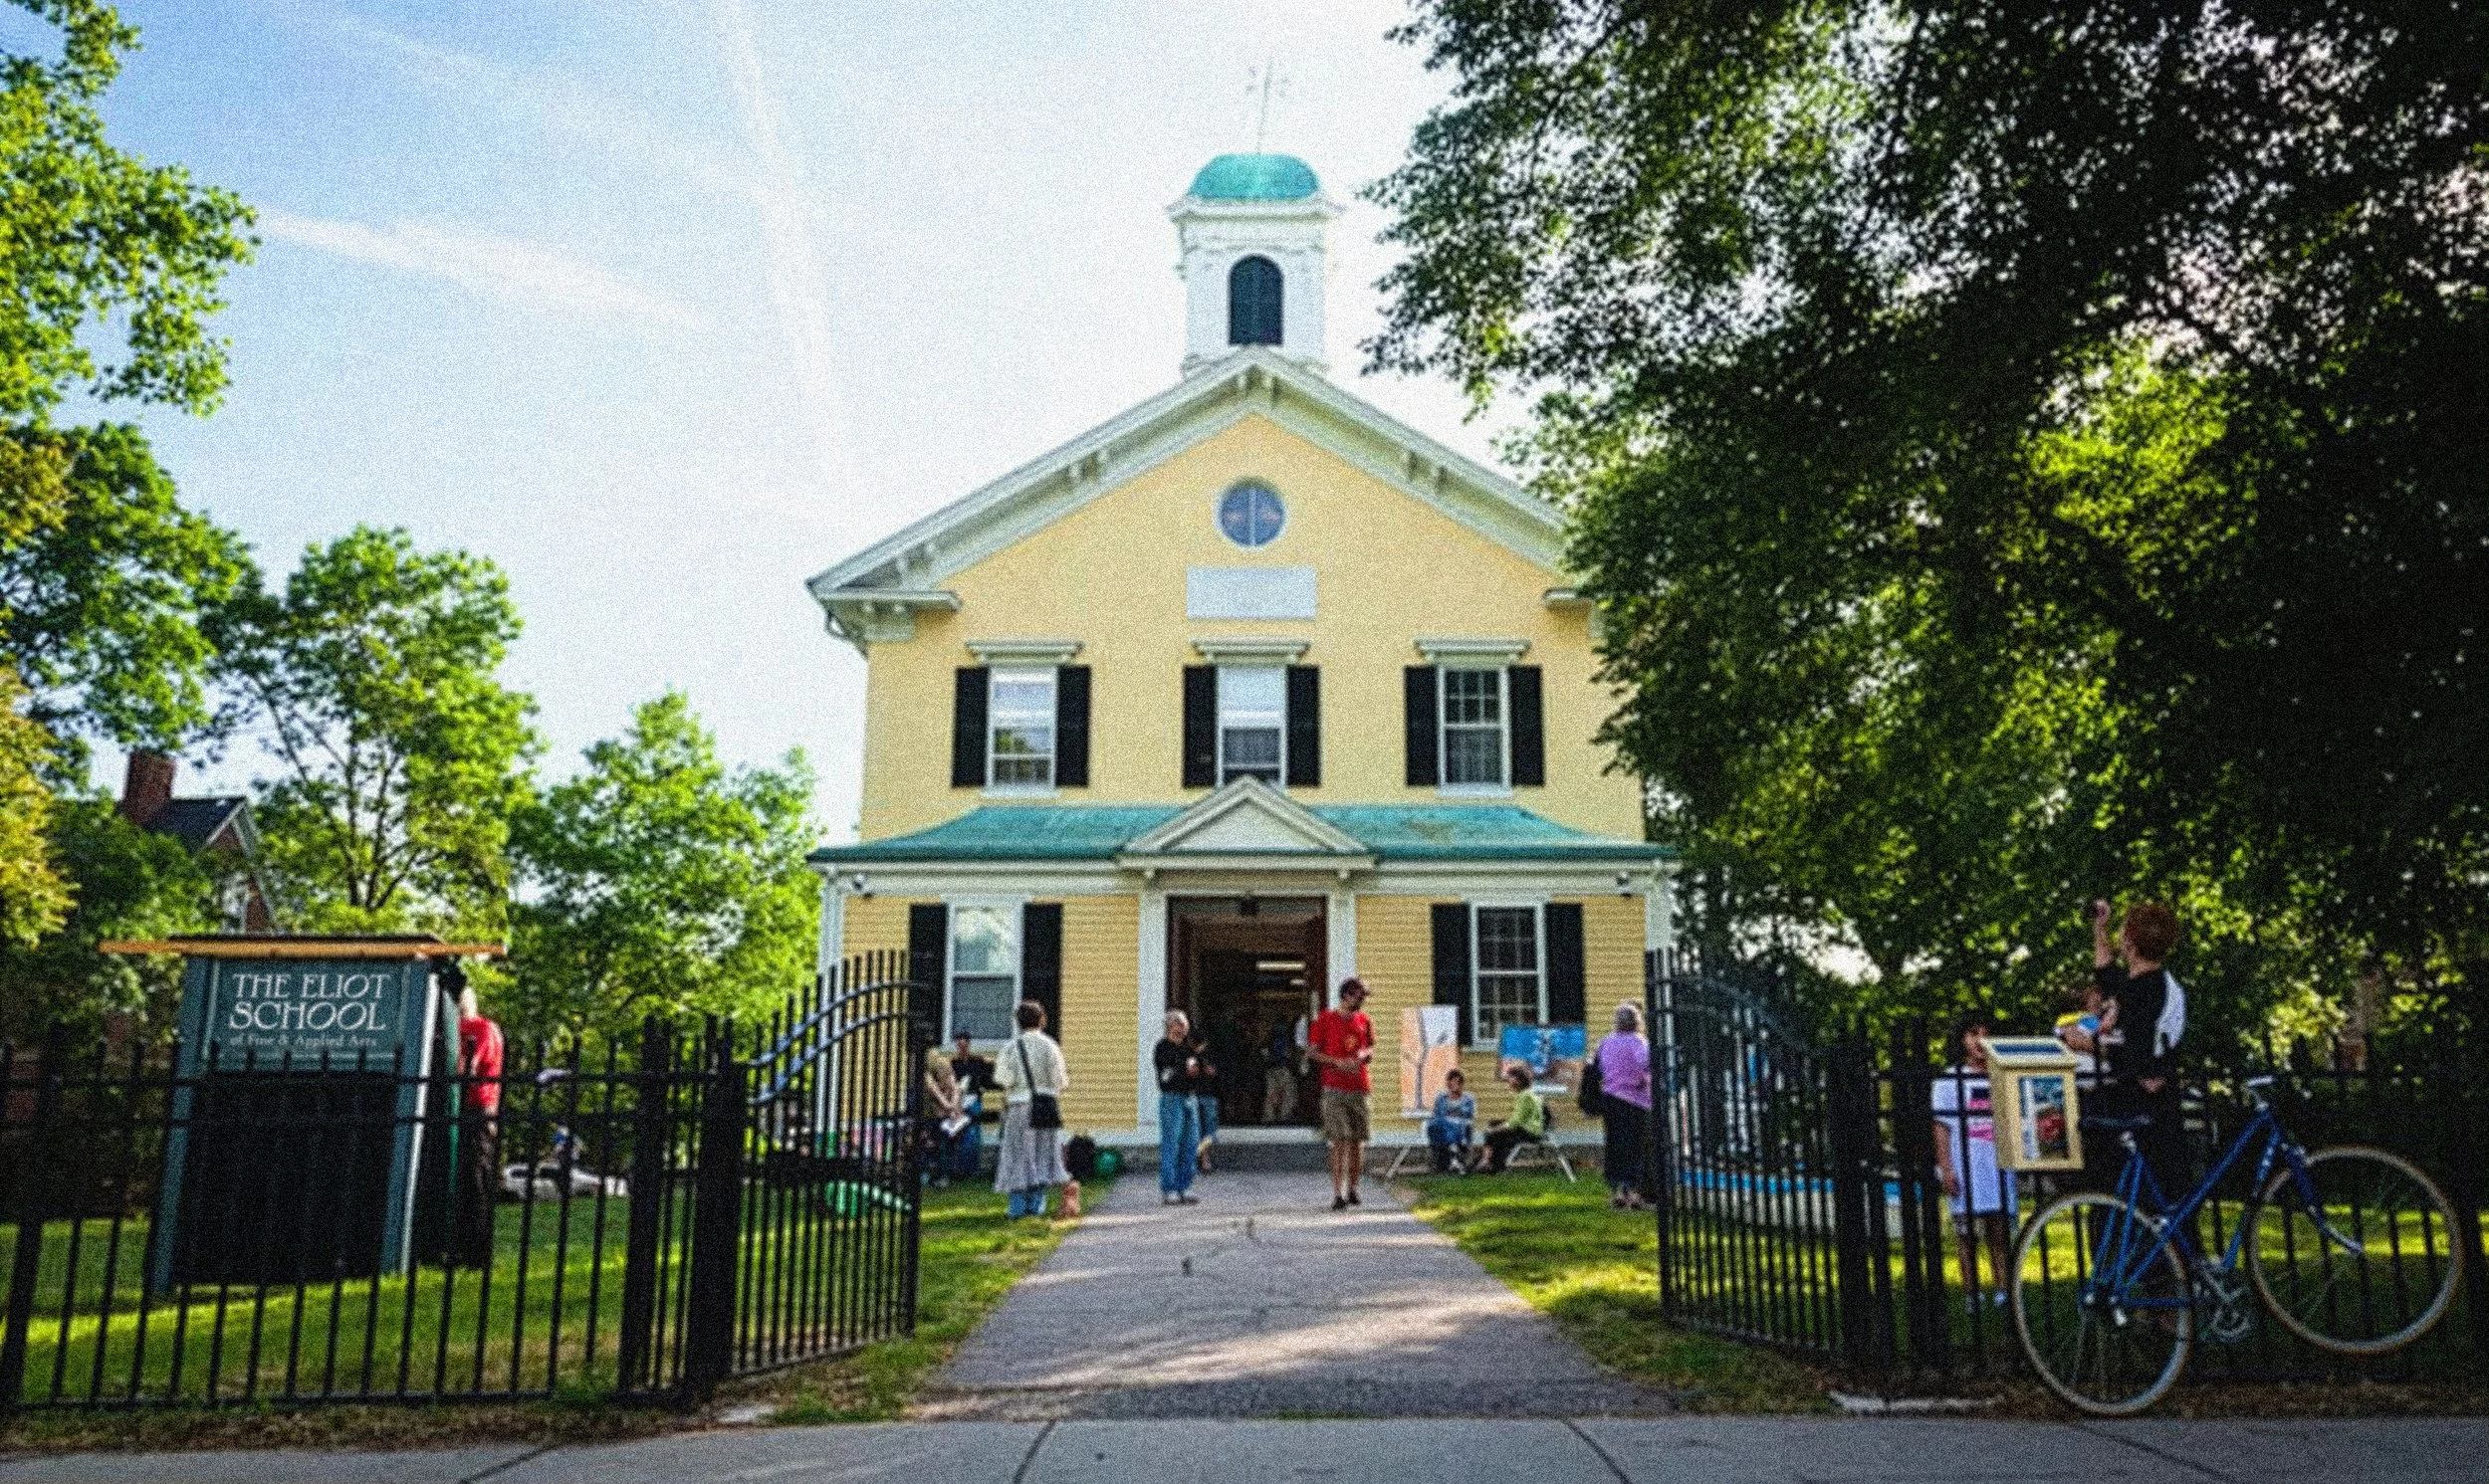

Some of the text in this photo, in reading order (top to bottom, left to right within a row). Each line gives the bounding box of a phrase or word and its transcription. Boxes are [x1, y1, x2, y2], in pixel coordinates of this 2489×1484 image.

[232, 972, 391, 998] THE ELIOT
[228, 1000, 387, 1030] SCHOOL
[230, 1033, 377, 1049] of Fine & Applied Arts
